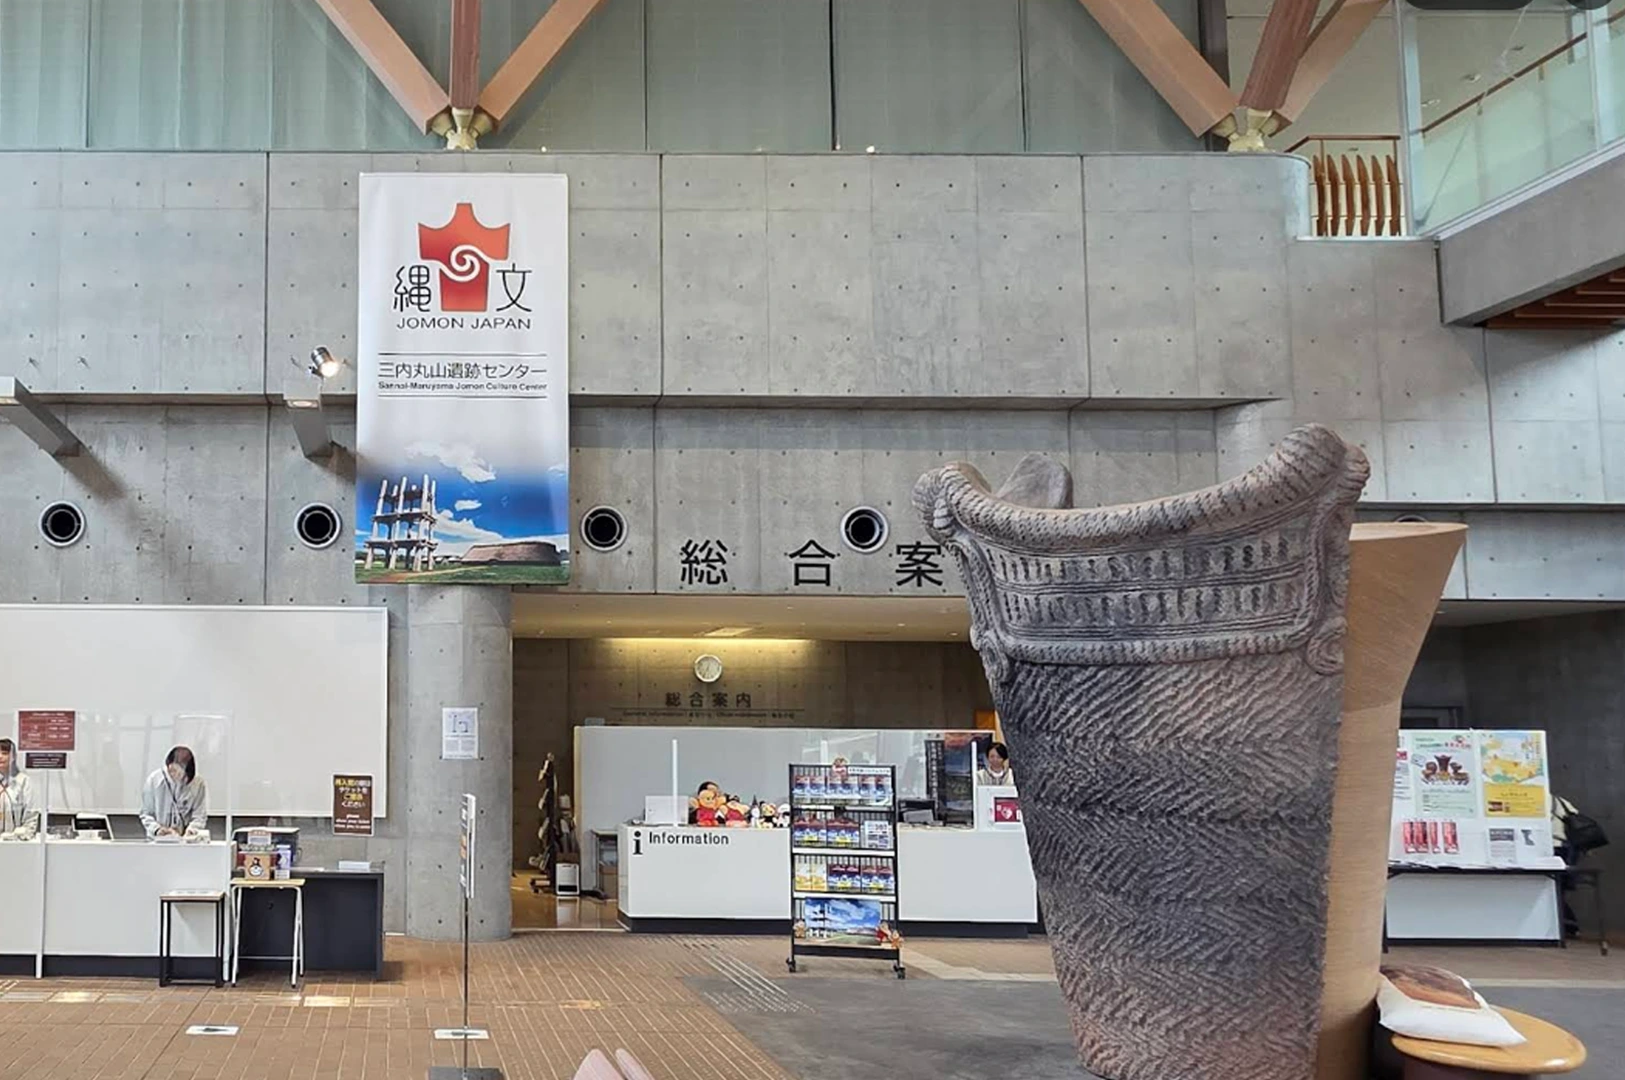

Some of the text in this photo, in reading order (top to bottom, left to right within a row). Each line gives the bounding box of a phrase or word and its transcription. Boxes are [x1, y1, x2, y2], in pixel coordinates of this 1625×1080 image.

[396, 317, 531, 330] JOMON JAPAN
[378, 362, 547, 379] 三内丸山遺跡センター
[455, 382, 484, 390] Jomon
[519, 383, 547, 391] Center
[665, 691, 752, 708] 総合案内
[649, 831, 729, 845] Information
